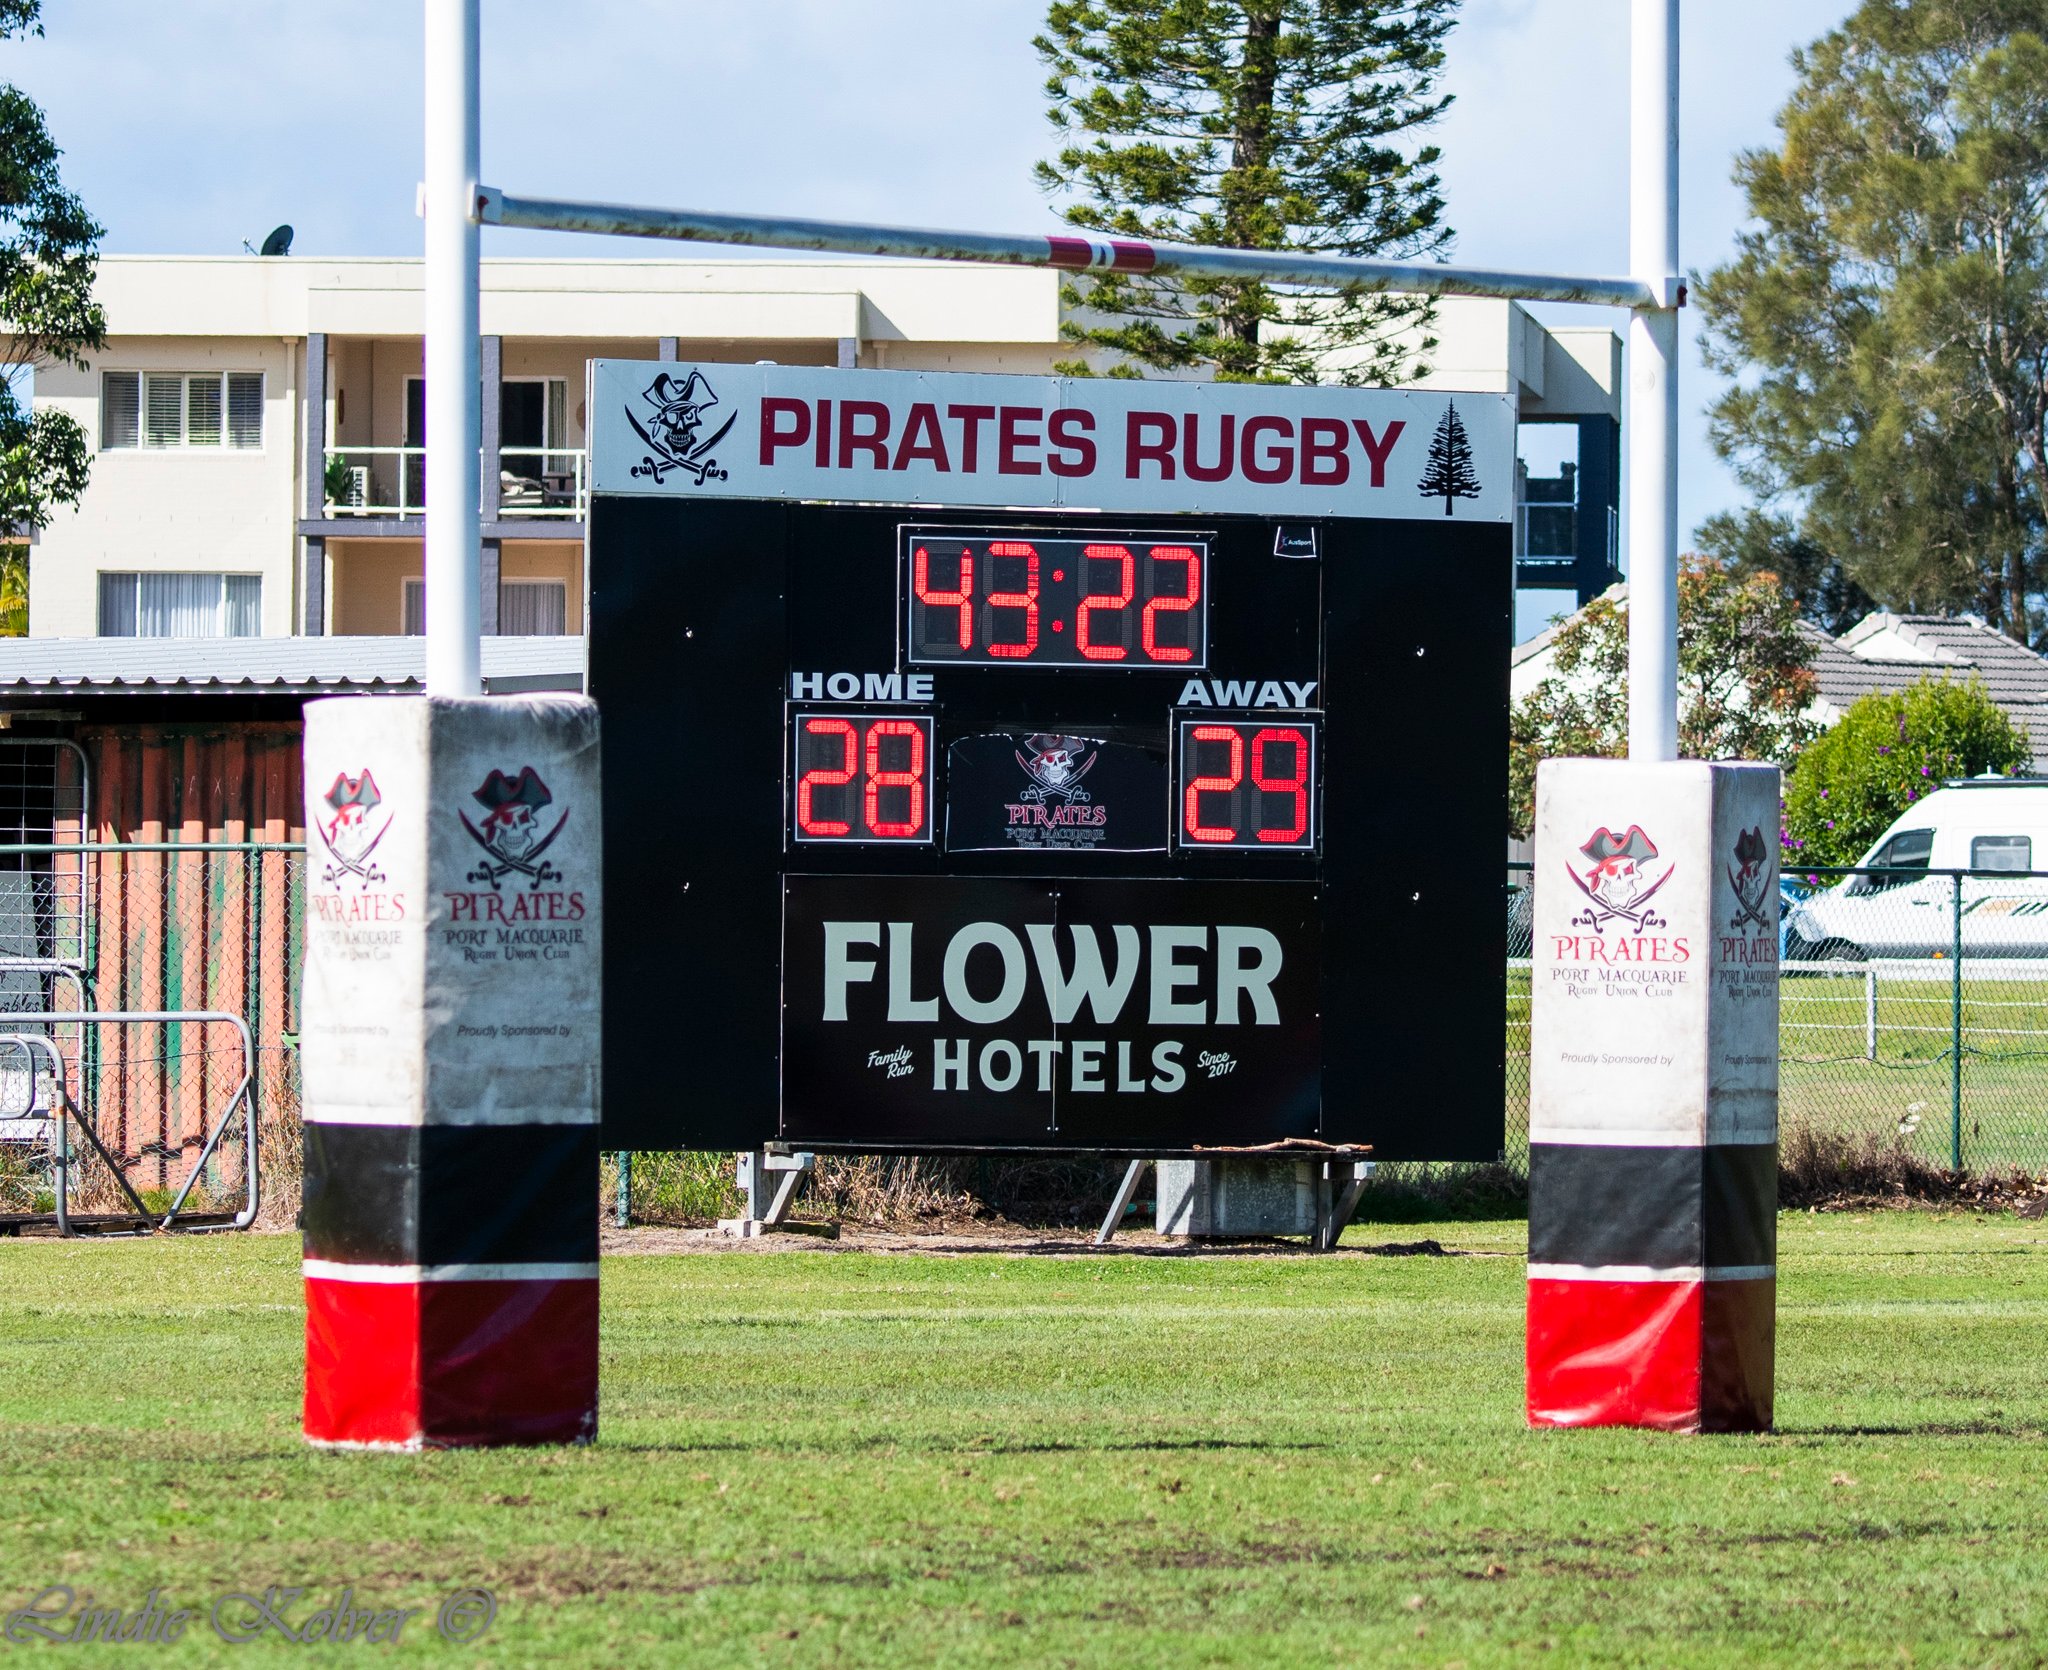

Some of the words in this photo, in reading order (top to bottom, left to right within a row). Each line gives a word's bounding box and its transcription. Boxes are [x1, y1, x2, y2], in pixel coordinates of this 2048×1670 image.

[759, 397, 1097, 478] PIRATES
[1125, 410, 1407, 488] RUGBY
[914, 542, 1200, 661] 43:22
[791, 672, 935, 701] HOME
[1177, 679, 1318, 708] AWAY
[799, 720, 925, 837] 28
[1186, 727, 1308, 842] 29
[1004, 804, 1106, 829] PIRATES
[1004, 828, 1037, 841] PORT
[312, 893, 405, 928] PIRATES
[443, 892, 586, 928] PIRATES
[442, 928, 488, 947] PORT
[496, 927, 585, 946] MACQUARIE
[1550, 936, 1690, 966] PIRATES
[1720, 938, 1777, 968] PIRATES
[822, 921, 1283, 1025] FLOWER
[1550, 968, 1590, 983] PORT
[1598, 968, 1689, 985] MACQUARIE
[1718, 970, 1740, 986] PORT
[457, 1024, 498, 1039] Proudly
[501, 1024, 557, 1037] Sponsored
[558, 1024, 572, 1037] by
[867, 1045, 913, 1068] Family
[887, 1062, 914, 1079] Run
[933, 1038, 1187, 1093] HOTELS
[1197, 1050, 1230, 1068] Since
[1208, 1060, 1237, 1078] 2017
[1561, 1053, 1598, 1066] Proudly
[1601, 1053, 1658, 1065] Sponsored
[1660, 1054, 1675, 1067] by
